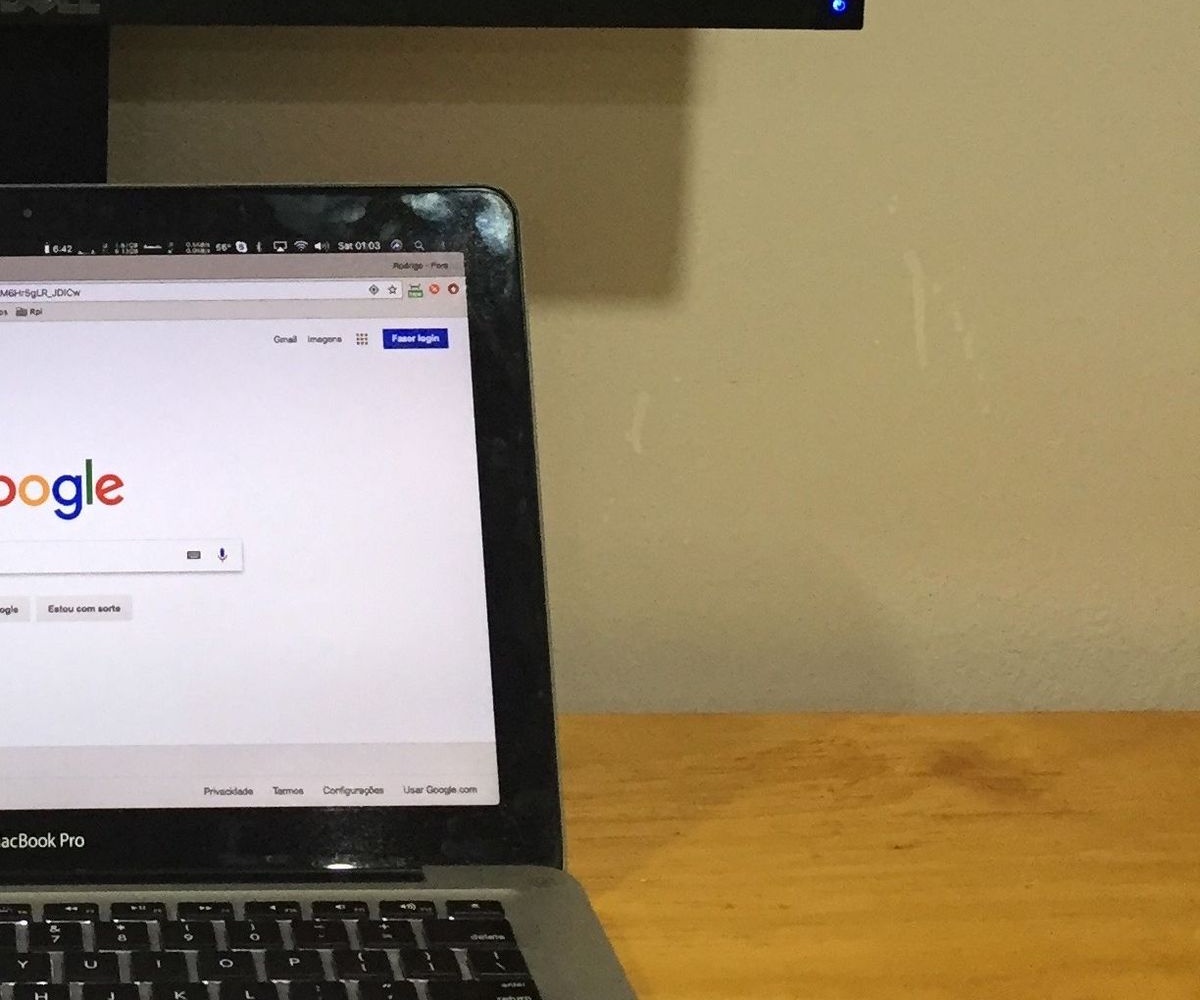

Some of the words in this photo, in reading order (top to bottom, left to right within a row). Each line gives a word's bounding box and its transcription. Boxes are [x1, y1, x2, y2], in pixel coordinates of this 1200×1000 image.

[273, 335, 298, 344] Gmail
[47, 604, 75, 614] Estou
[97, 604, 121, 613] sorte
[272, 786, 305, 796] Termos
[59, 832, 85, 848] Pro
